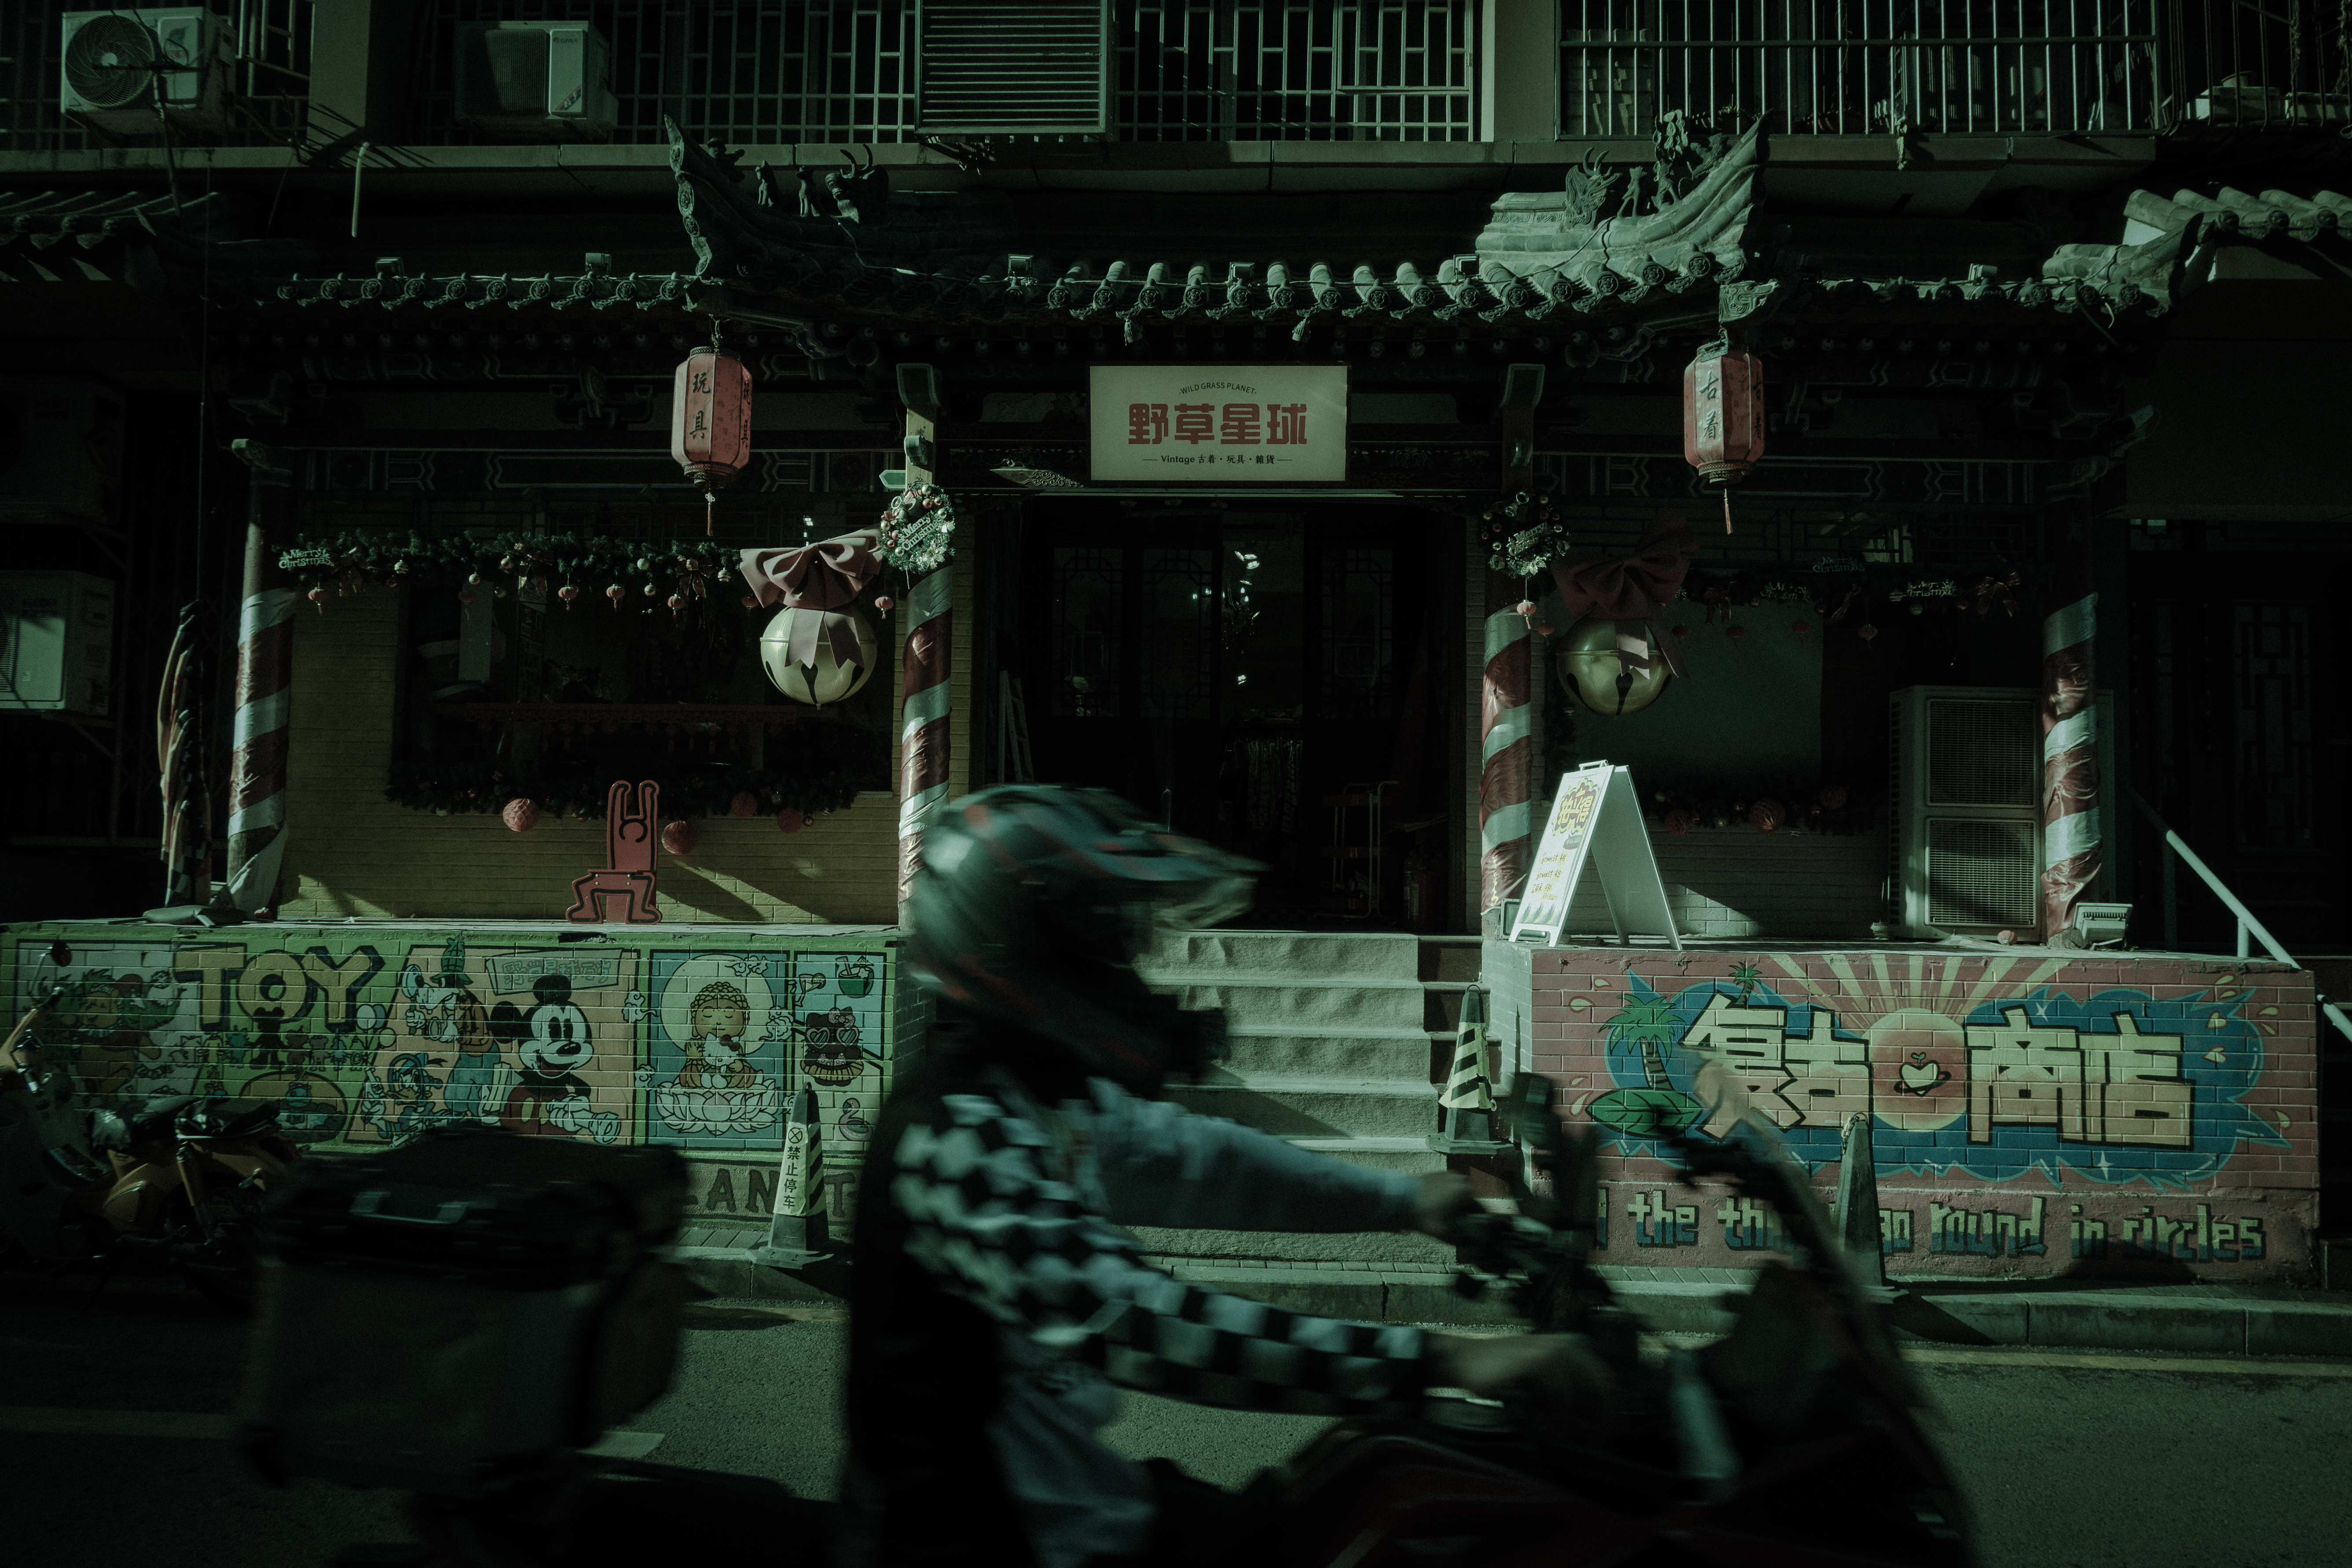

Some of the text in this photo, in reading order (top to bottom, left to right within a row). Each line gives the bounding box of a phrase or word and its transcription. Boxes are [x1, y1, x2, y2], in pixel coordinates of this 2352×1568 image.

[689, 372, 711, 439] 玩具
[1699, 370, 1718, 440] 古着
[1128, 403, 1307, 444] 野草星球
[1161, 455, 1195, 464] Vintage
[902, 512, 931, 538] Merry
[902, 518, 944, 551] Christmas
[1513, 523, 1545, 543] Merry
[279, 557, 331, 569] Christmas
[290, 548, 321, 558] Merry
[1812, 564, 1865, 573] Christmas
[1821, 556, 1854, 565] Merry
[1558, 788, 1594, 824] 拍立得
[176, 941, 386, 1032] TOY
[1678, 989, 2196, 1151] 复古 商店
[783, 1146, 801, 1210] 禁止停车
[1628, 1189, 1699, 1248] the
[1930, 1196, 2048, 1258] round
[2070, 1204, 2109, 1259] in
